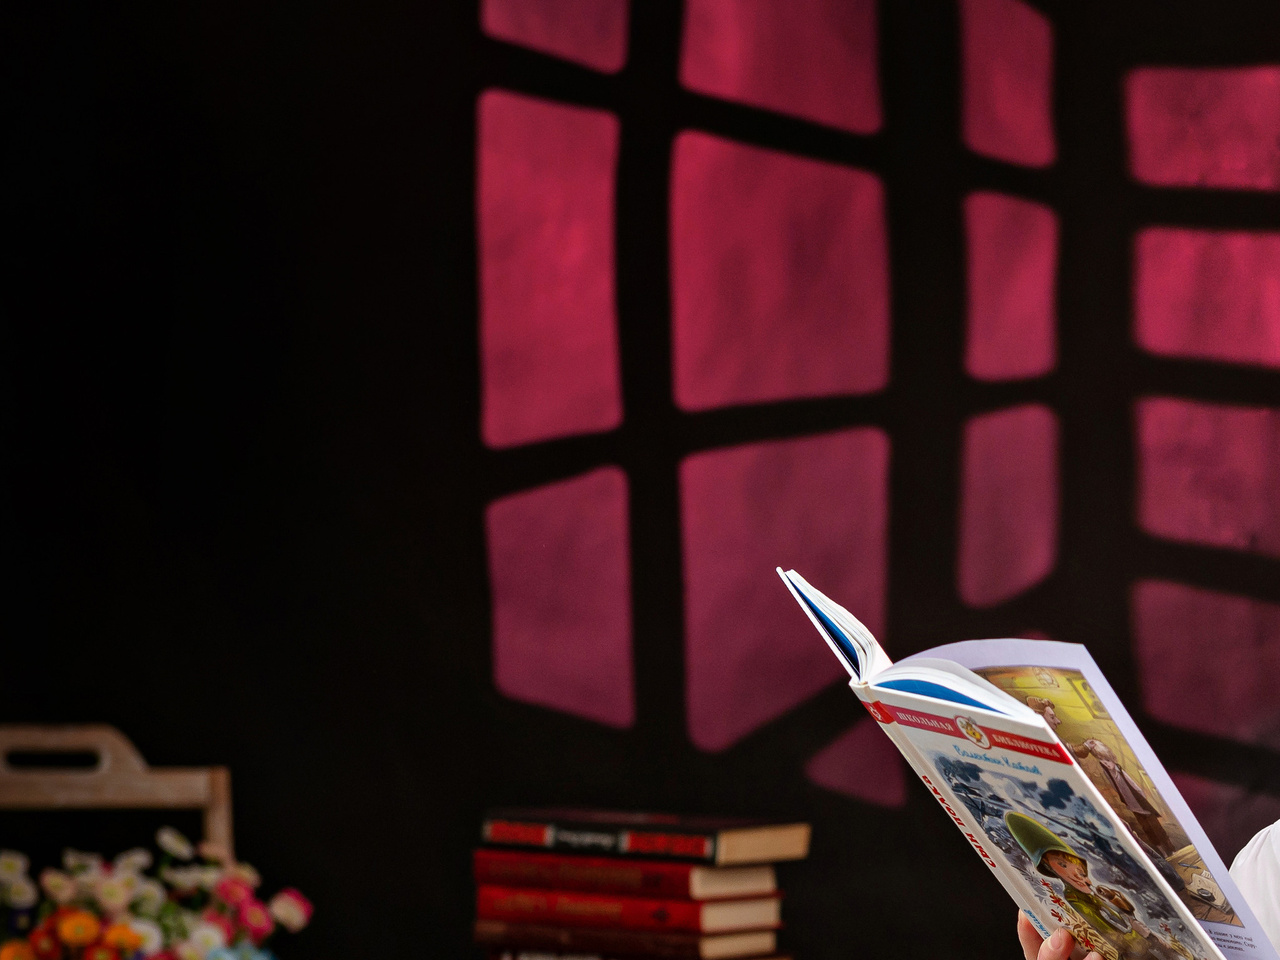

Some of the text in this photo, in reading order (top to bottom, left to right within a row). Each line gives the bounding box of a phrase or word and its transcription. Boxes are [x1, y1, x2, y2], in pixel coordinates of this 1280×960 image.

[896, 711, 954, 732] ШКОЛЬНАЯ
[922, 775, 997, 868] СЫН ПОЛКА
